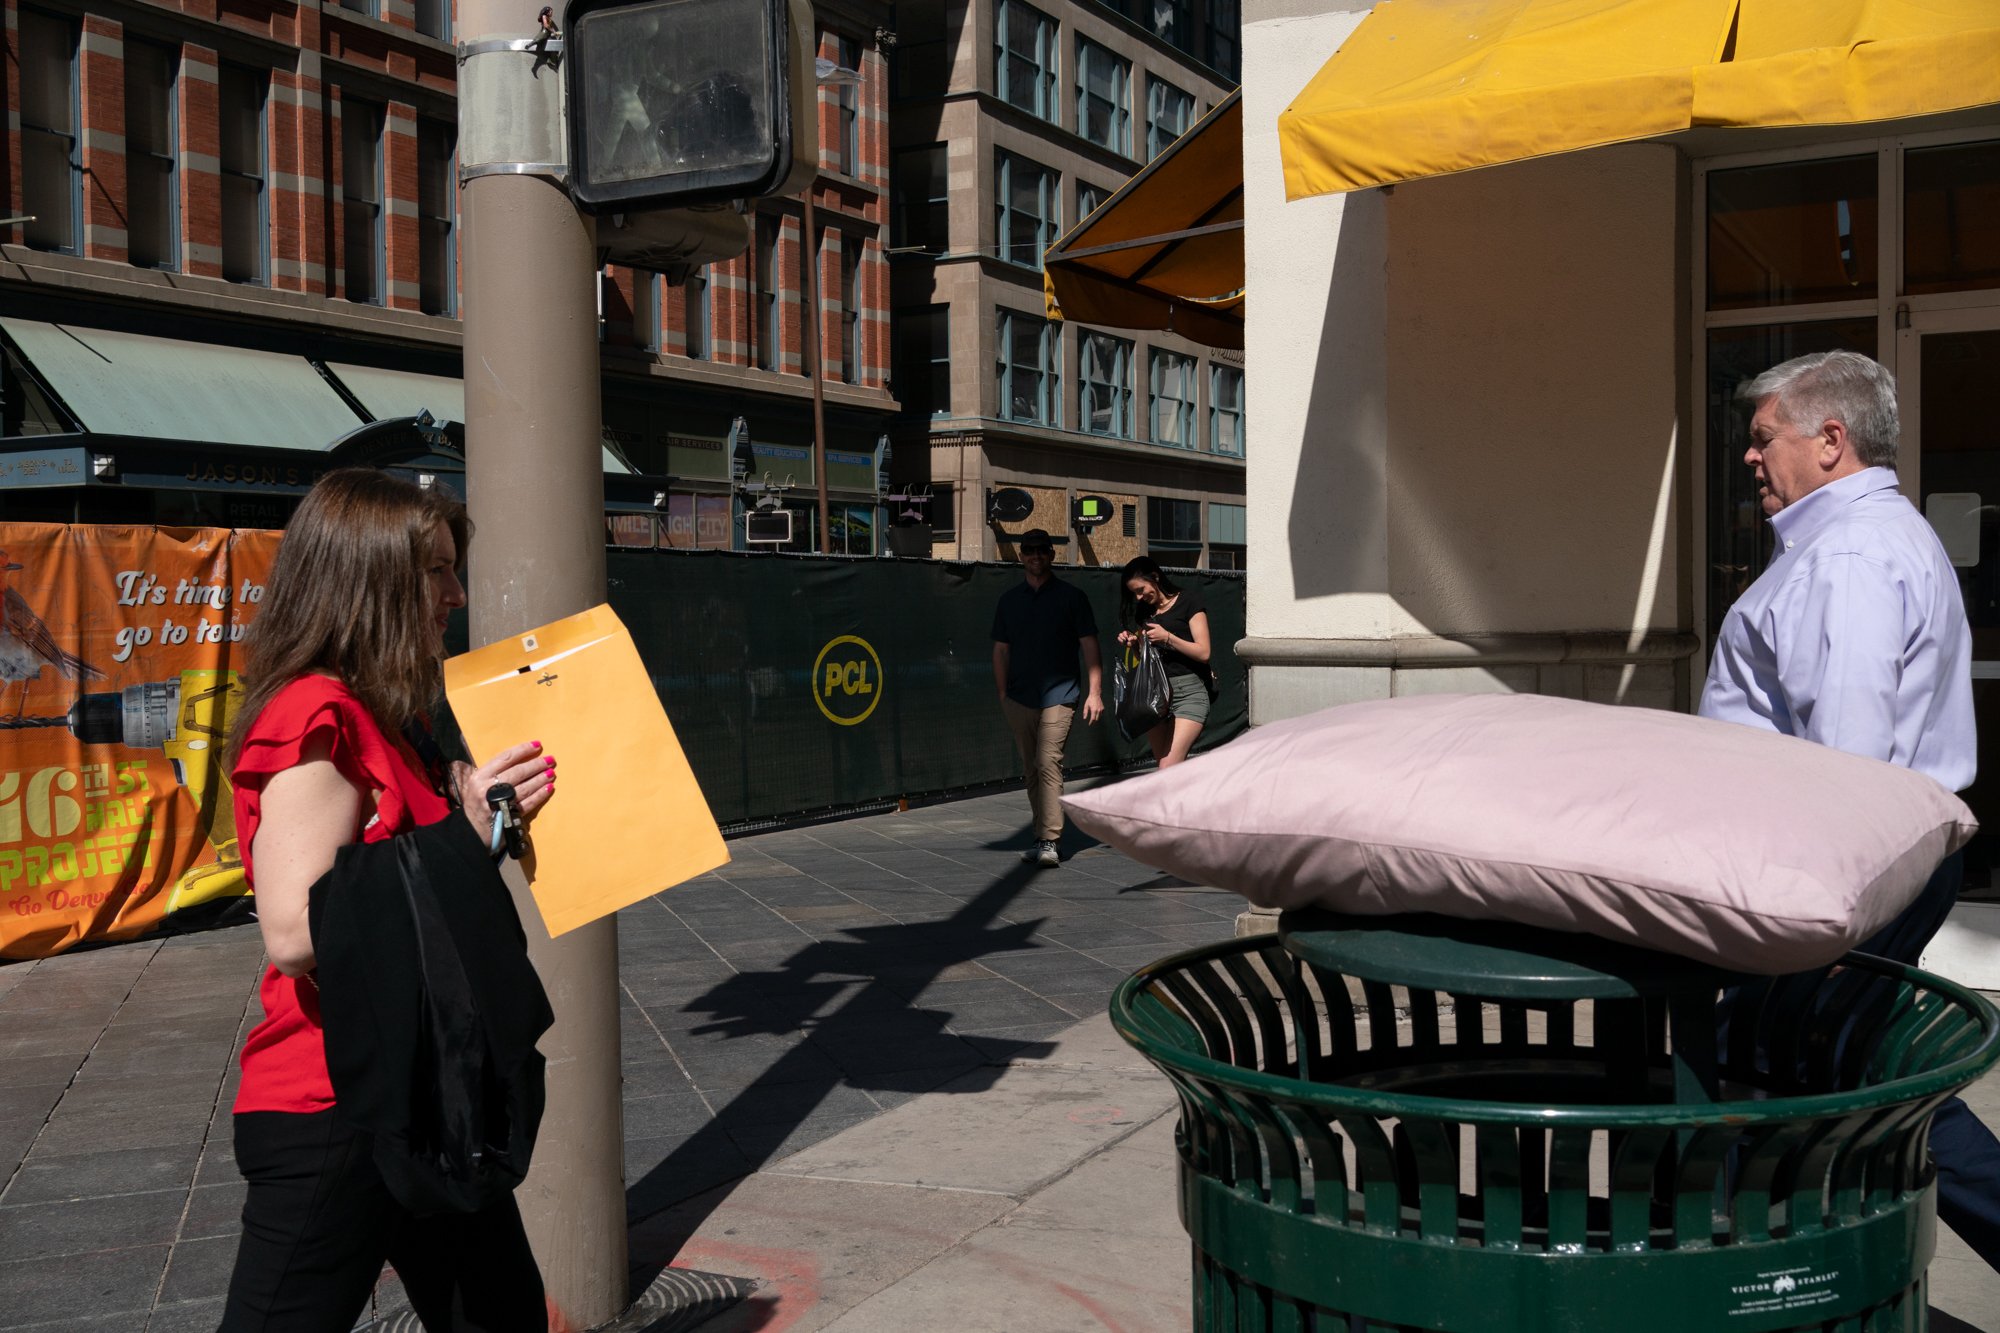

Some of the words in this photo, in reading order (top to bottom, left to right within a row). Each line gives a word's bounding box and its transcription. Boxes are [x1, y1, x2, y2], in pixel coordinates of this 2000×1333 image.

[684, 439, 722, 451] SERVICES
[185, 463, 298, 486] JASON'S
[229, 503, 281, 518] RETAIL
[613, 514, 651, 534] MILE
[697, 515, 728, 537] CITY
[116, 570, 168, 607] It's
[174, 576, 232, 610] time
[240, 578, 266, 604] to
[112, 626, 153, 663] go
[160, 618, 189, 645] to
[196, 617, 248, 644] tow
[824, 660, 873, 697] PCL
[115, 760, 150, 794] ST
[8, 895, 43, 916] Go
[1731, 1283, 1771, 1295] VICTOR
